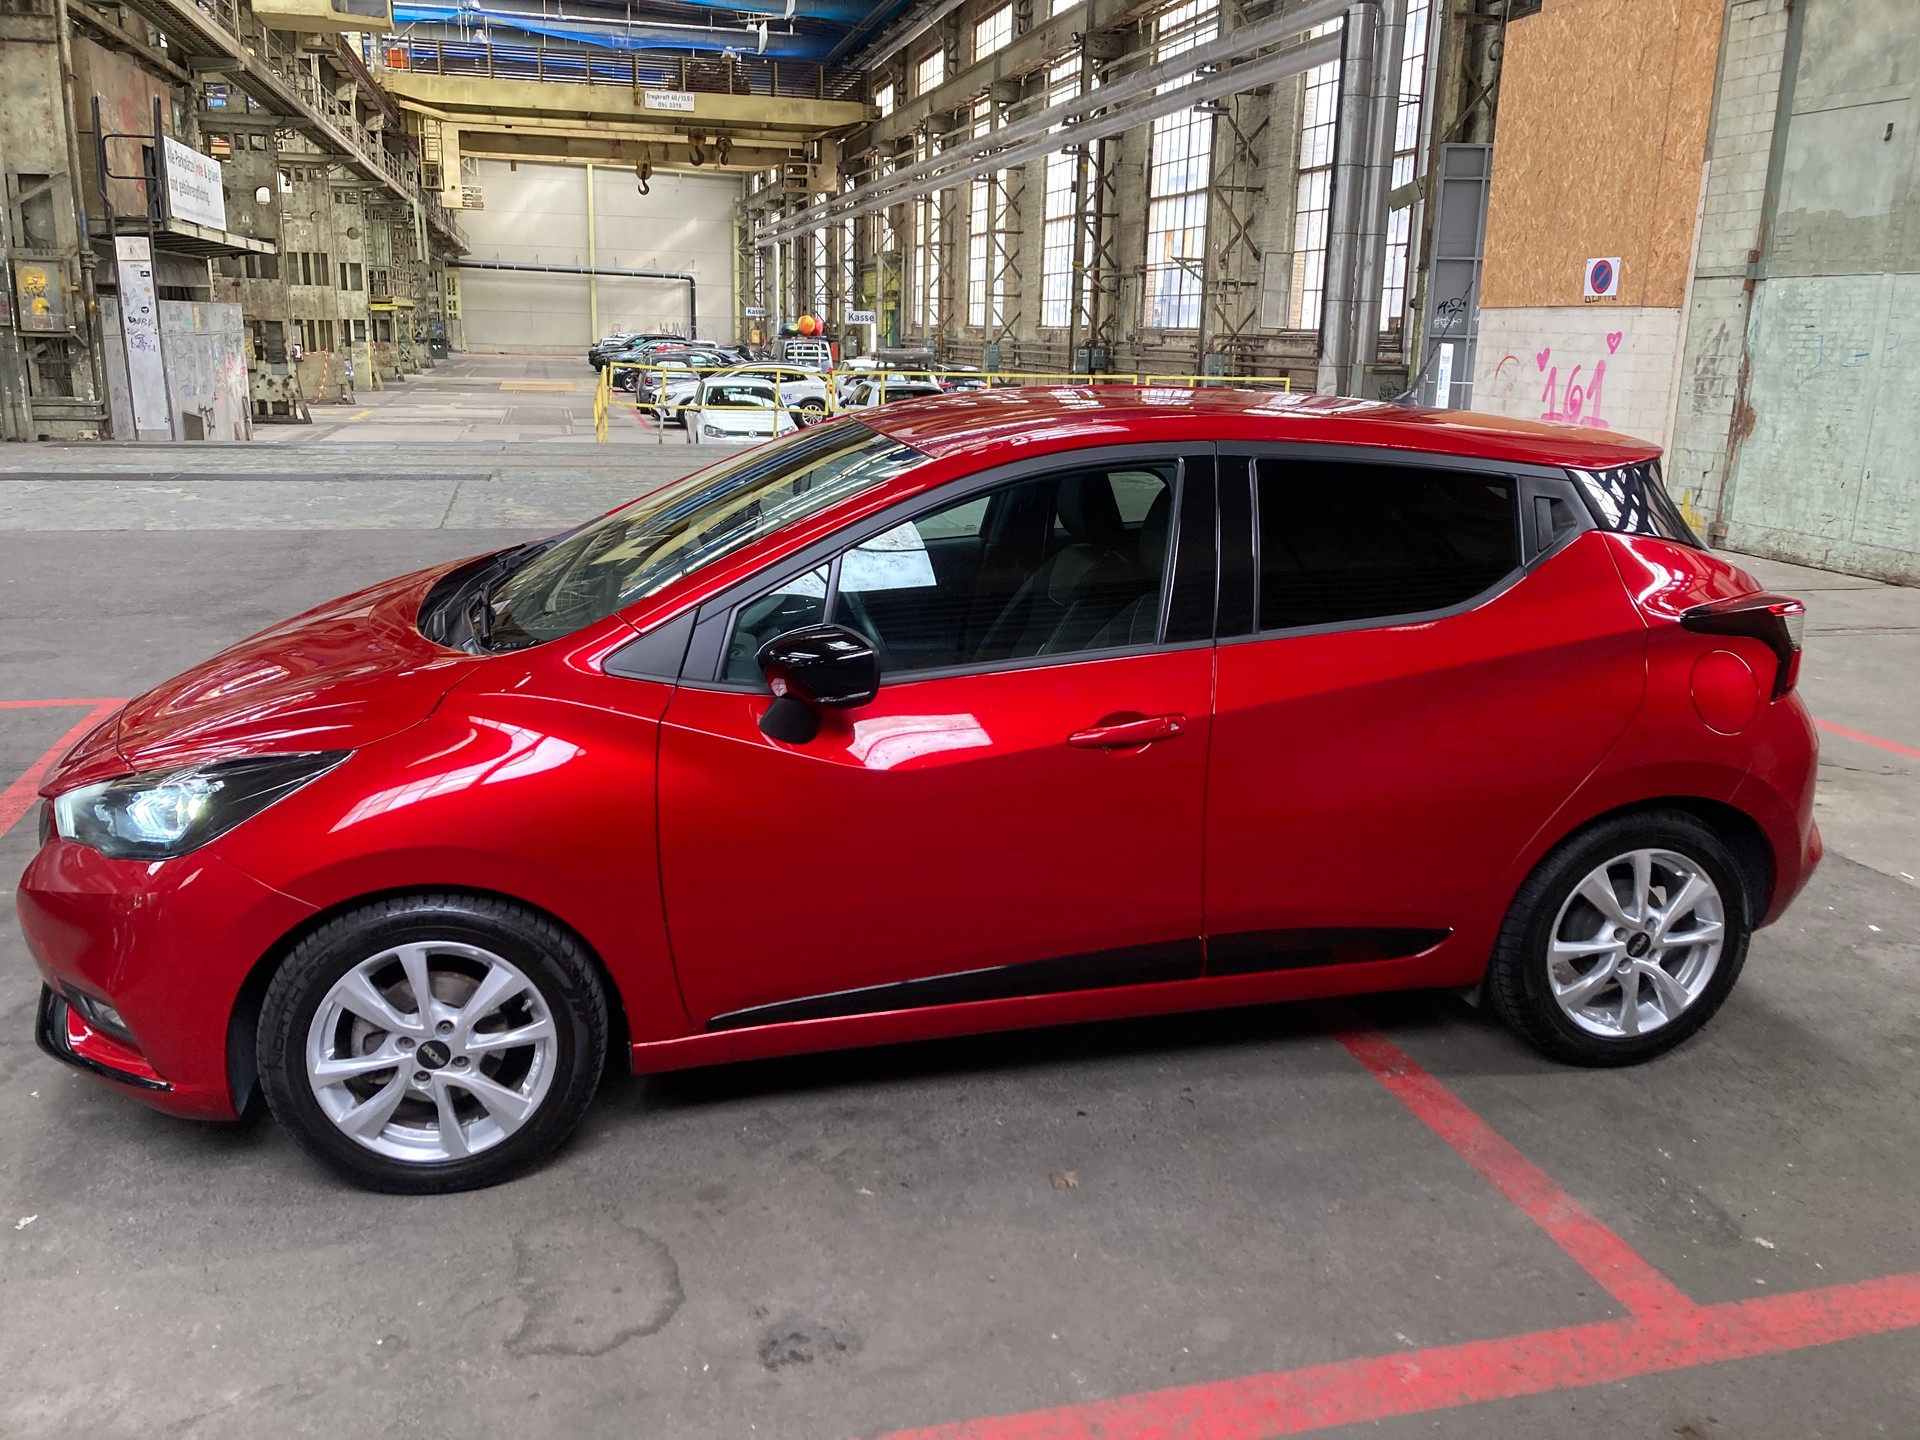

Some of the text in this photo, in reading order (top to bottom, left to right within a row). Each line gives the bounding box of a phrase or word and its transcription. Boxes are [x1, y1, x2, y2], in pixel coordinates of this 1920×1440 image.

[646, 93, 670, 101] Tragkraft
[848, 312, 875, 322] Kasse
[1541, 360, 1609, 429] 161
